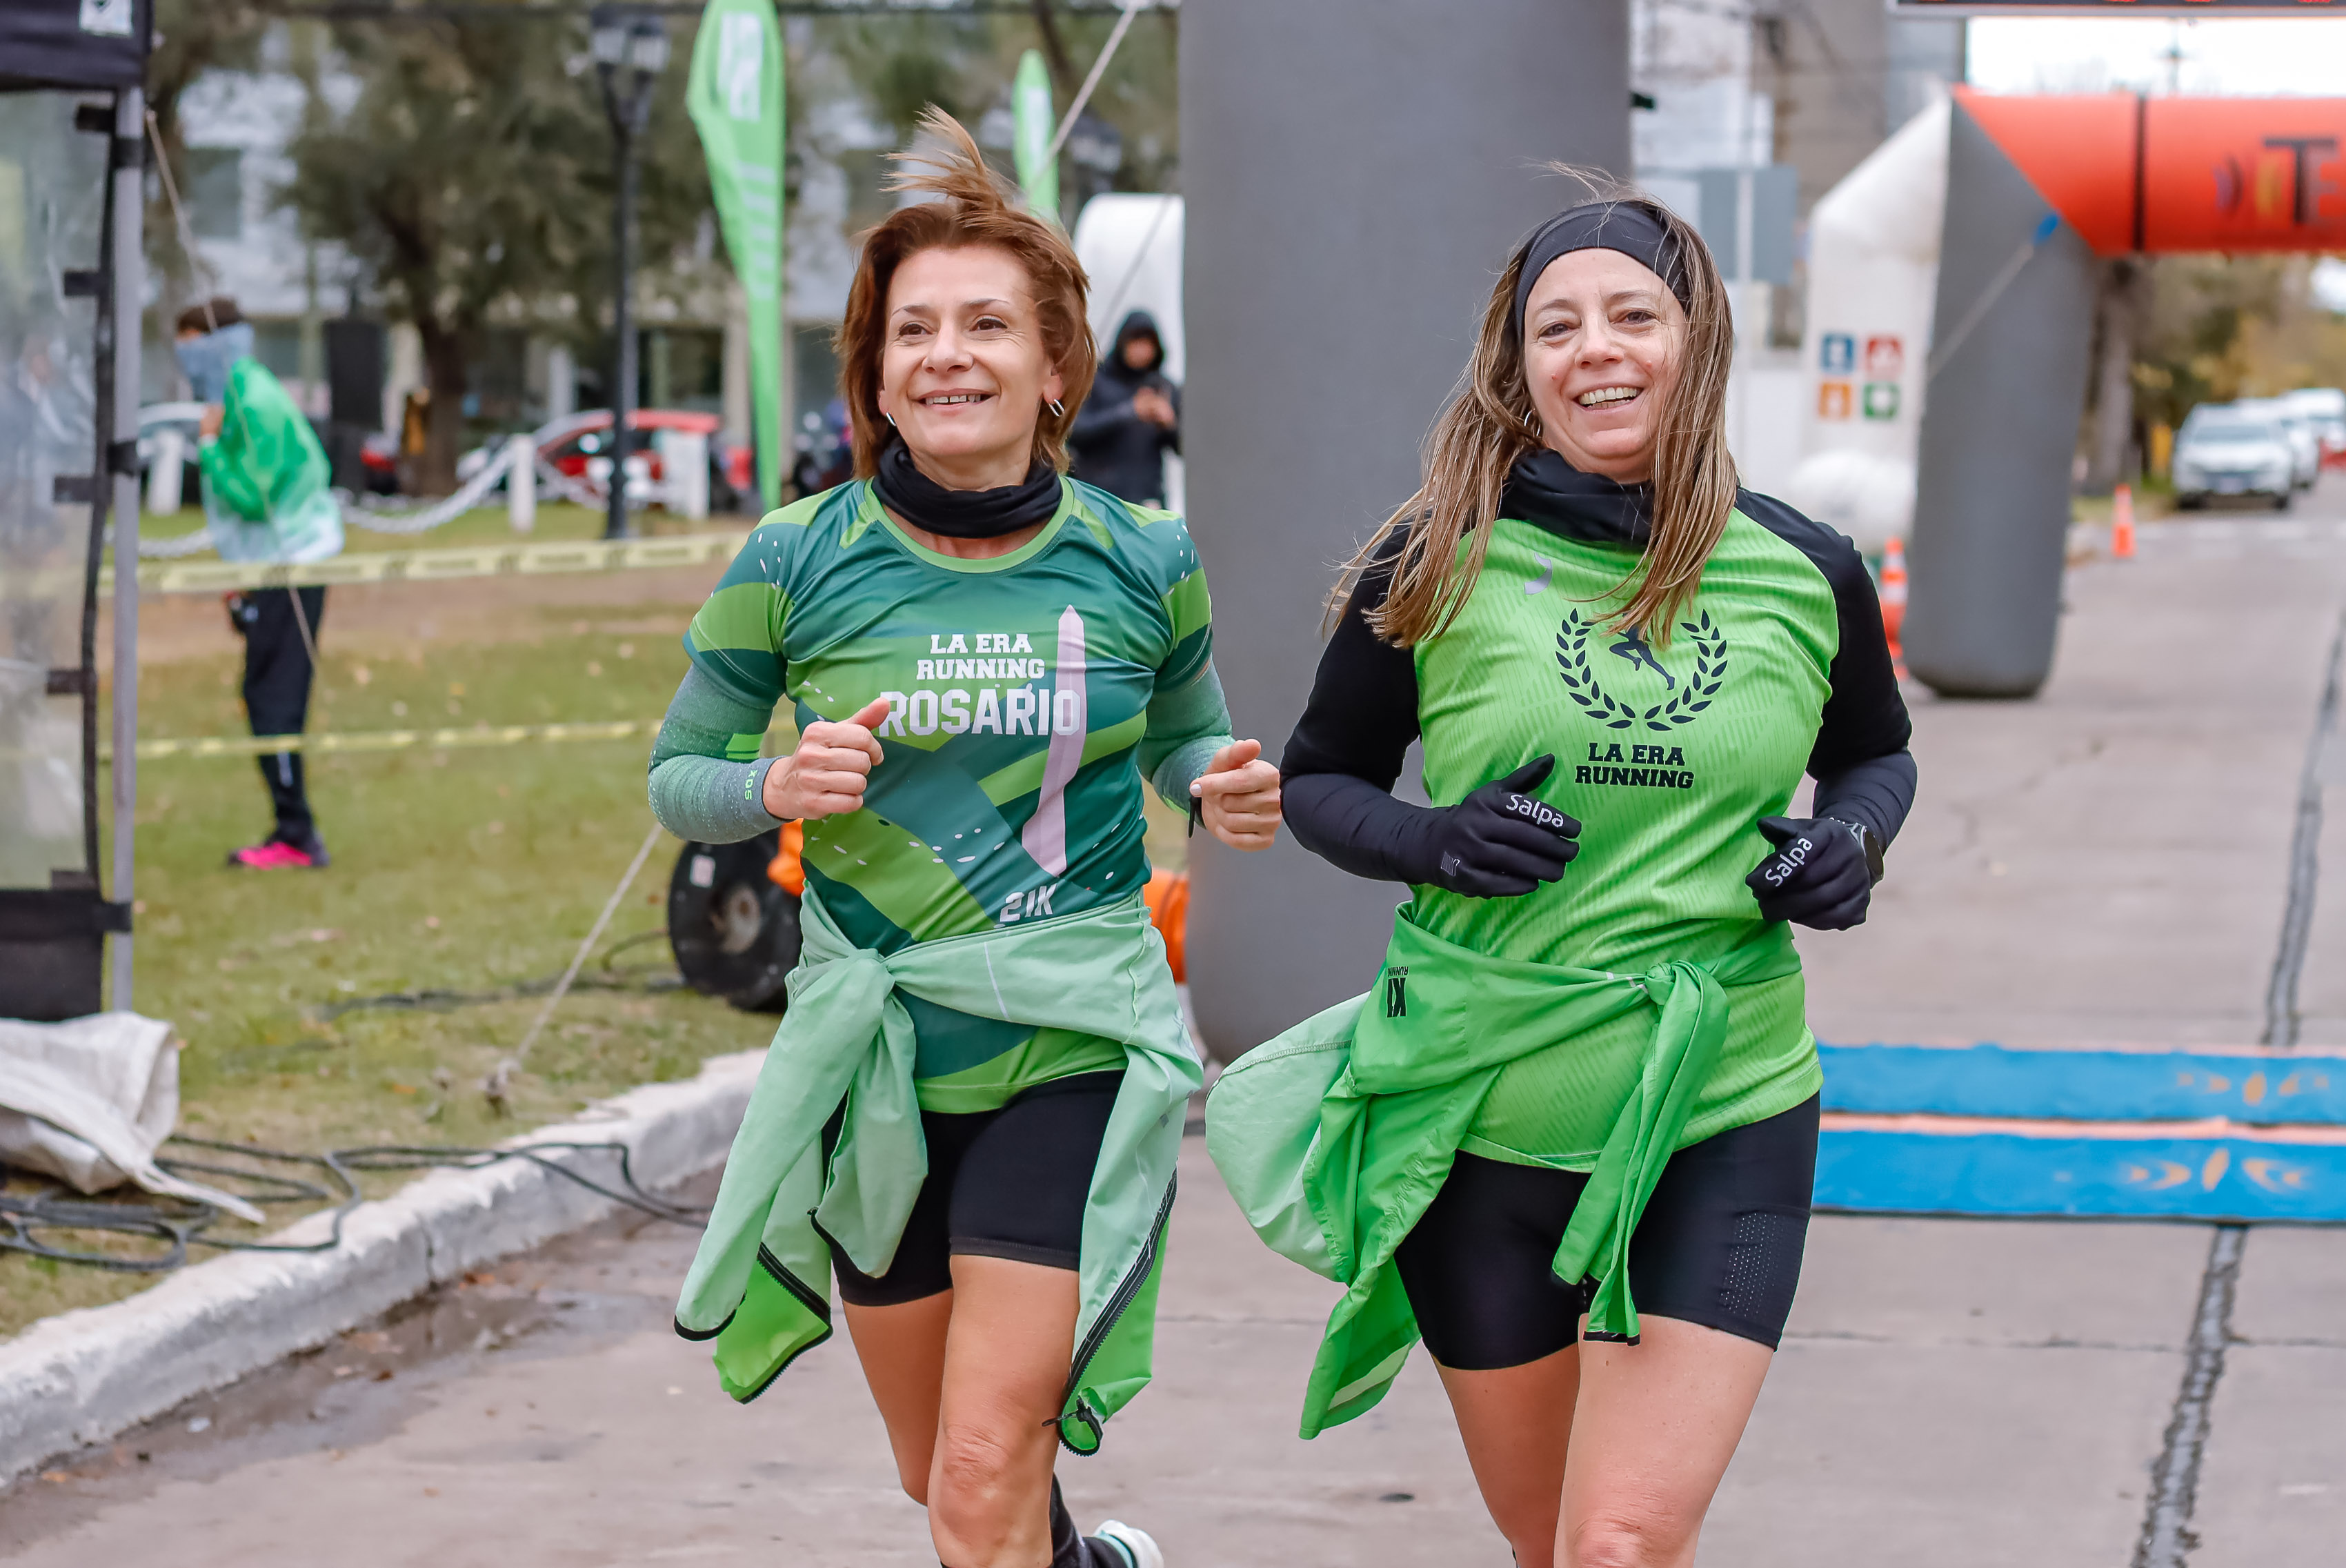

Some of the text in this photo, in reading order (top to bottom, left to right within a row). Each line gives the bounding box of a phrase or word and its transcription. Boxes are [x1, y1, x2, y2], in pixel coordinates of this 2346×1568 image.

[931, 633, 1033, 654] LA ERA
[916, 658, 1045, 680] RUNNING
[879, 688, 1081, 737] ROSARIO
[1588, 742, 1685, 766] LA ERA
[1575, 765, 1695, 789] RUNNING
[1506, 794, 1564, 828] Salpa
[1765, 837, 1813, 887] Salpa
[1000, 883, 1057, 922] 21K
